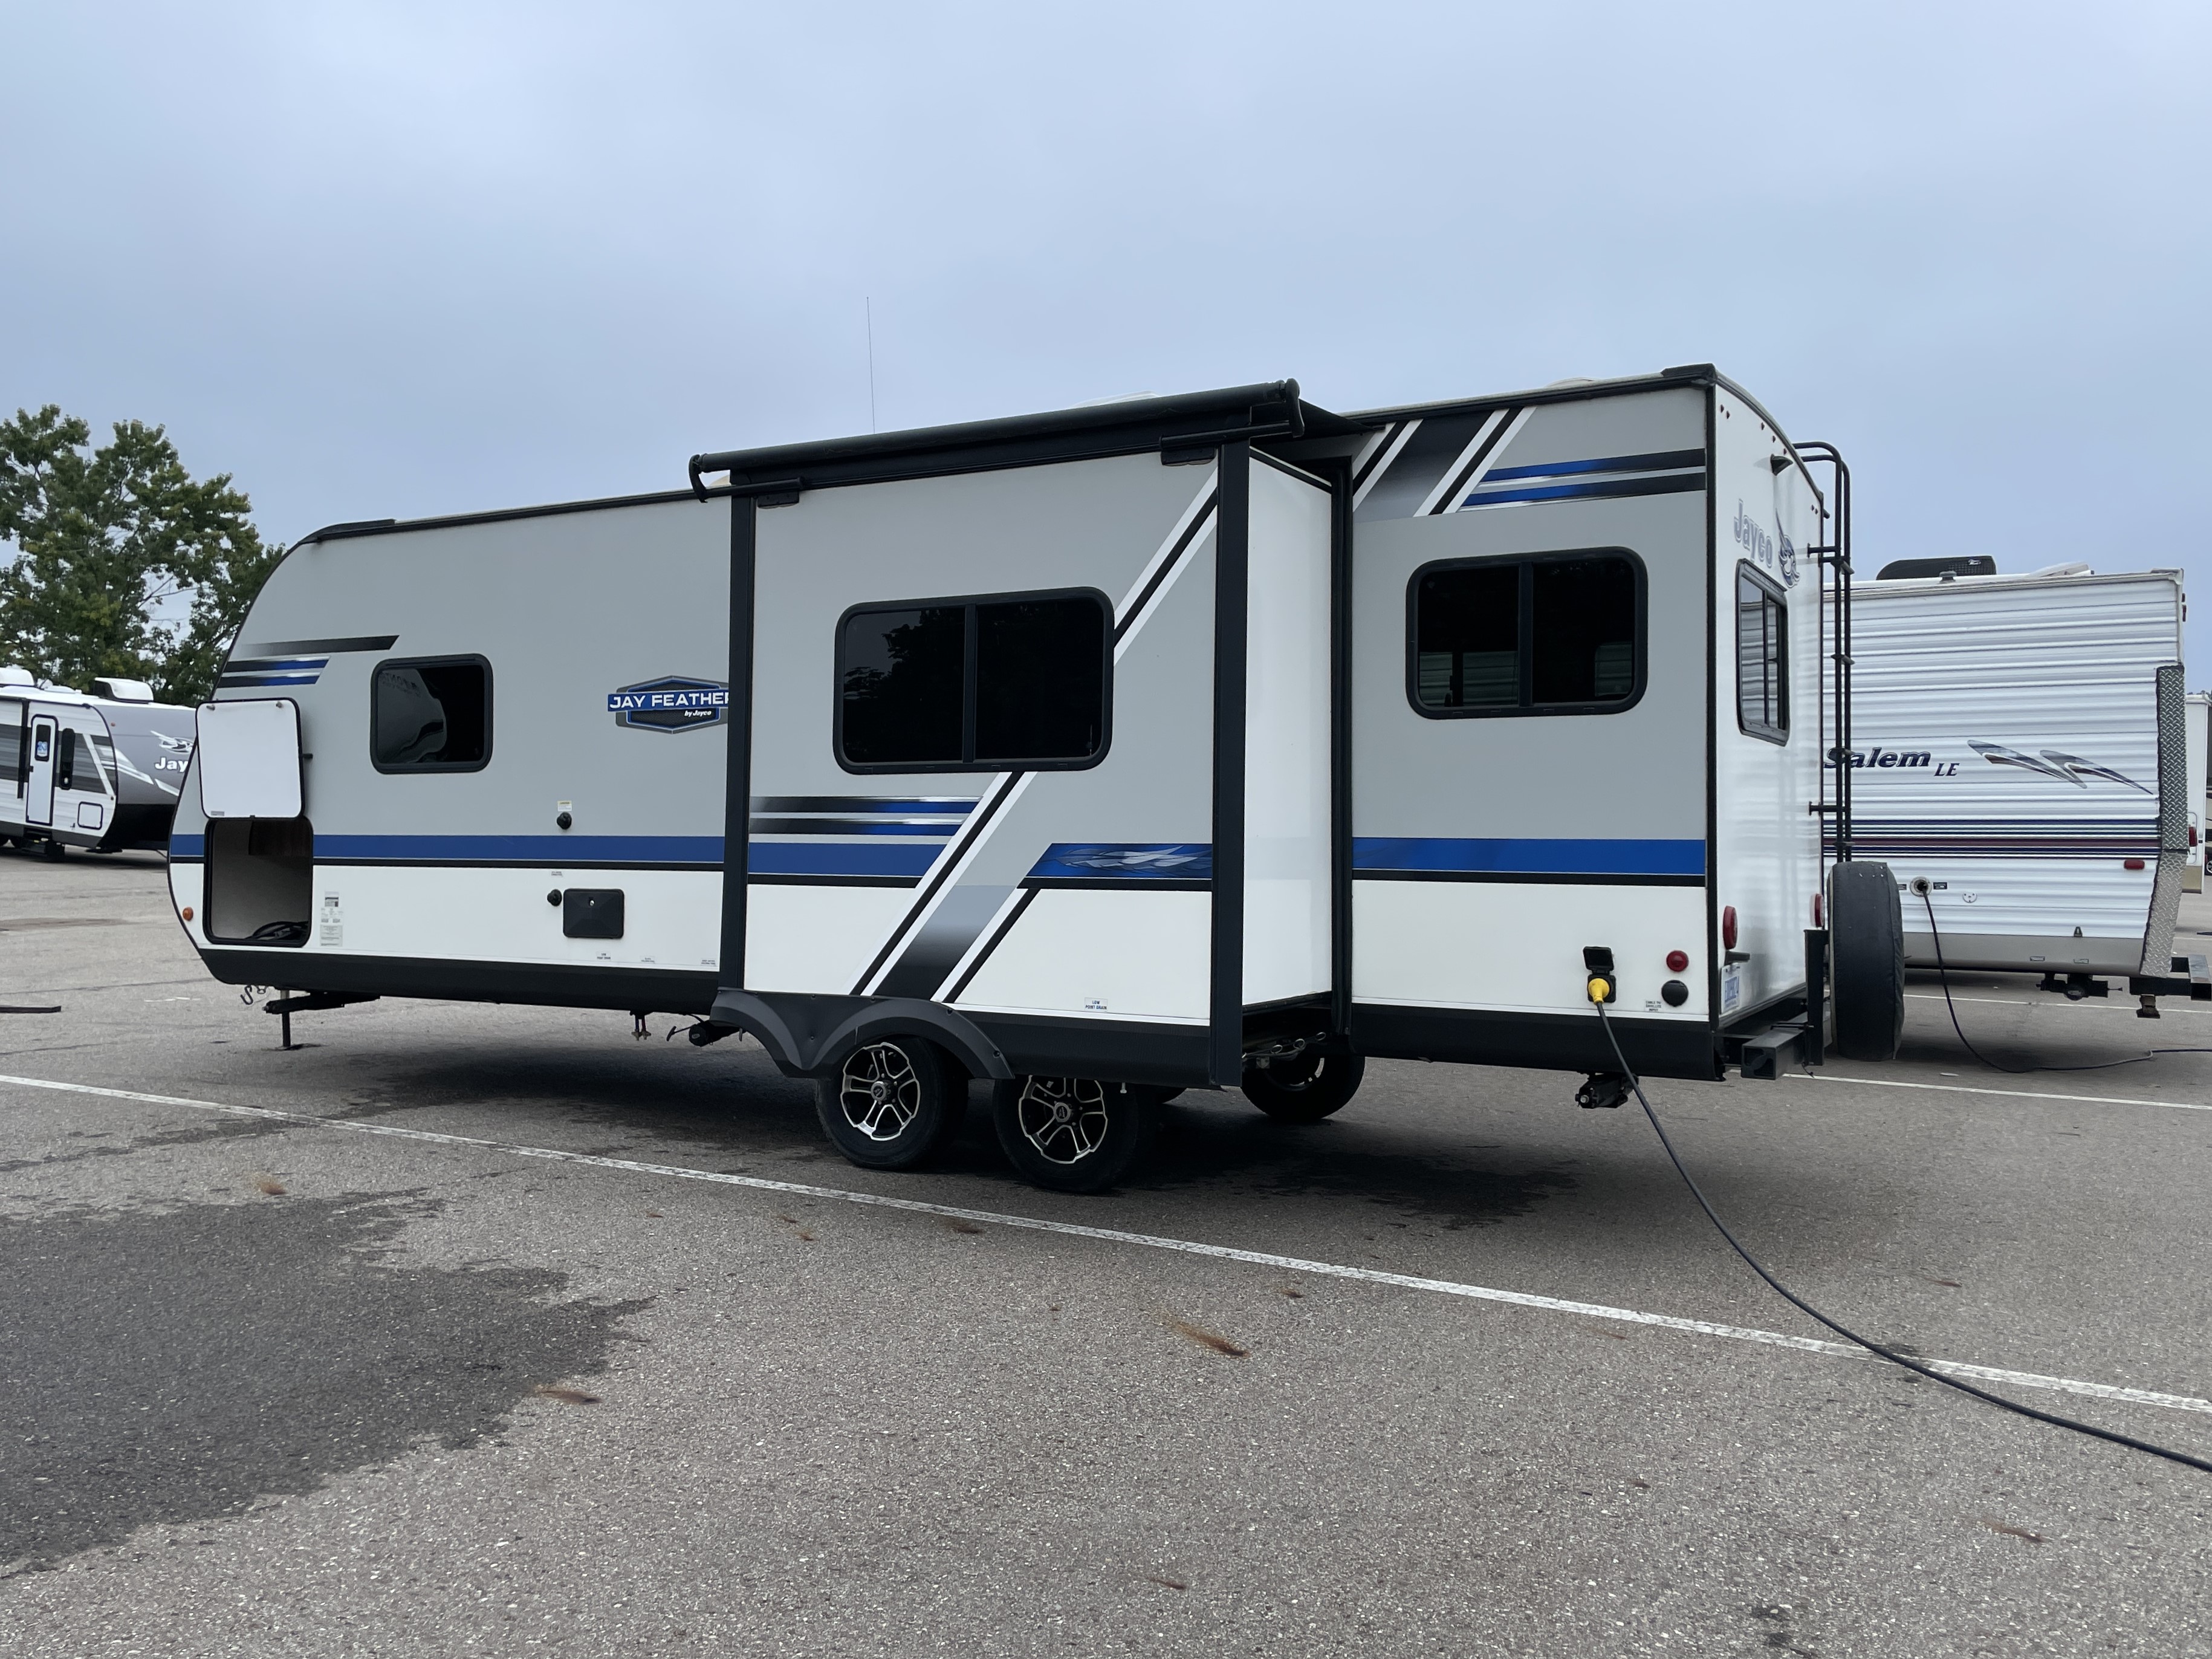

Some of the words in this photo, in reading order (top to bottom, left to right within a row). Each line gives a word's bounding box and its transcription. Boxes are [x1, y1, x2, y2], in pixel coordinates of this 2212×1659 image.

[1734, 498, 1773, 568] Jayco
[609, 695, 646, 709] JAY
[1934, 762, 1960, 776] LE
